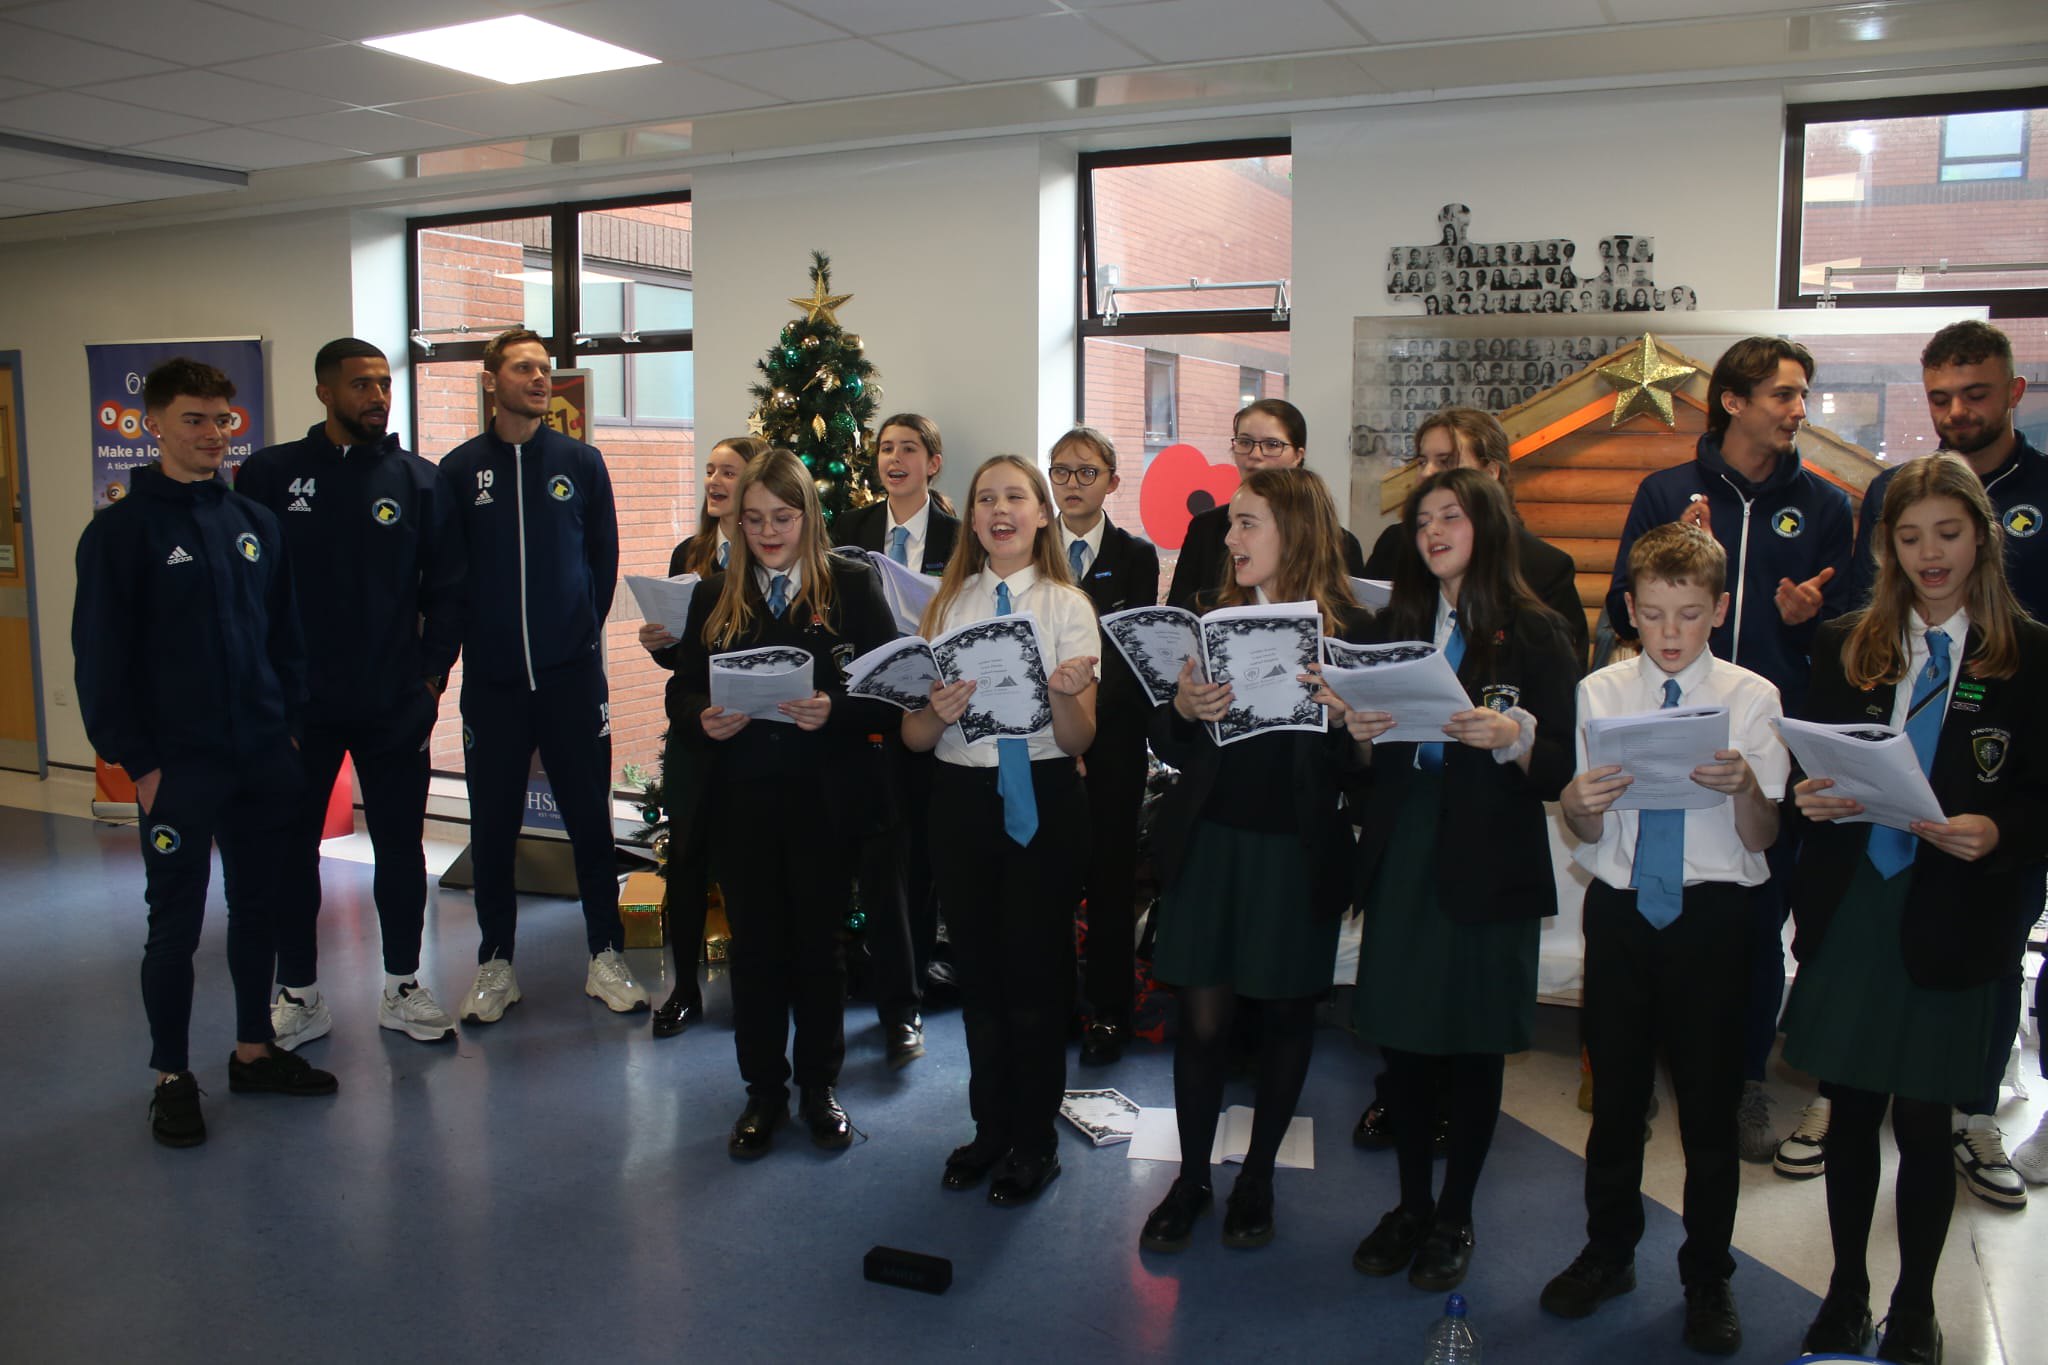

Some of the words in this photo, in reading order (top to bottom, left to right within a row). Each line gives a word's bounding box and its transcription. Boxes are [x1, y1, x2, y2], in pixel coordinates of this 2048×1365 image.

[98, 445, 133, 457] Make
[136, 448, 144, 457] a
[147, 445, 160, 457] lo
[288, 477, 316, 496] 44
[476, 469, 494, 489] 19
[167, 555, 193, 564] adidas
